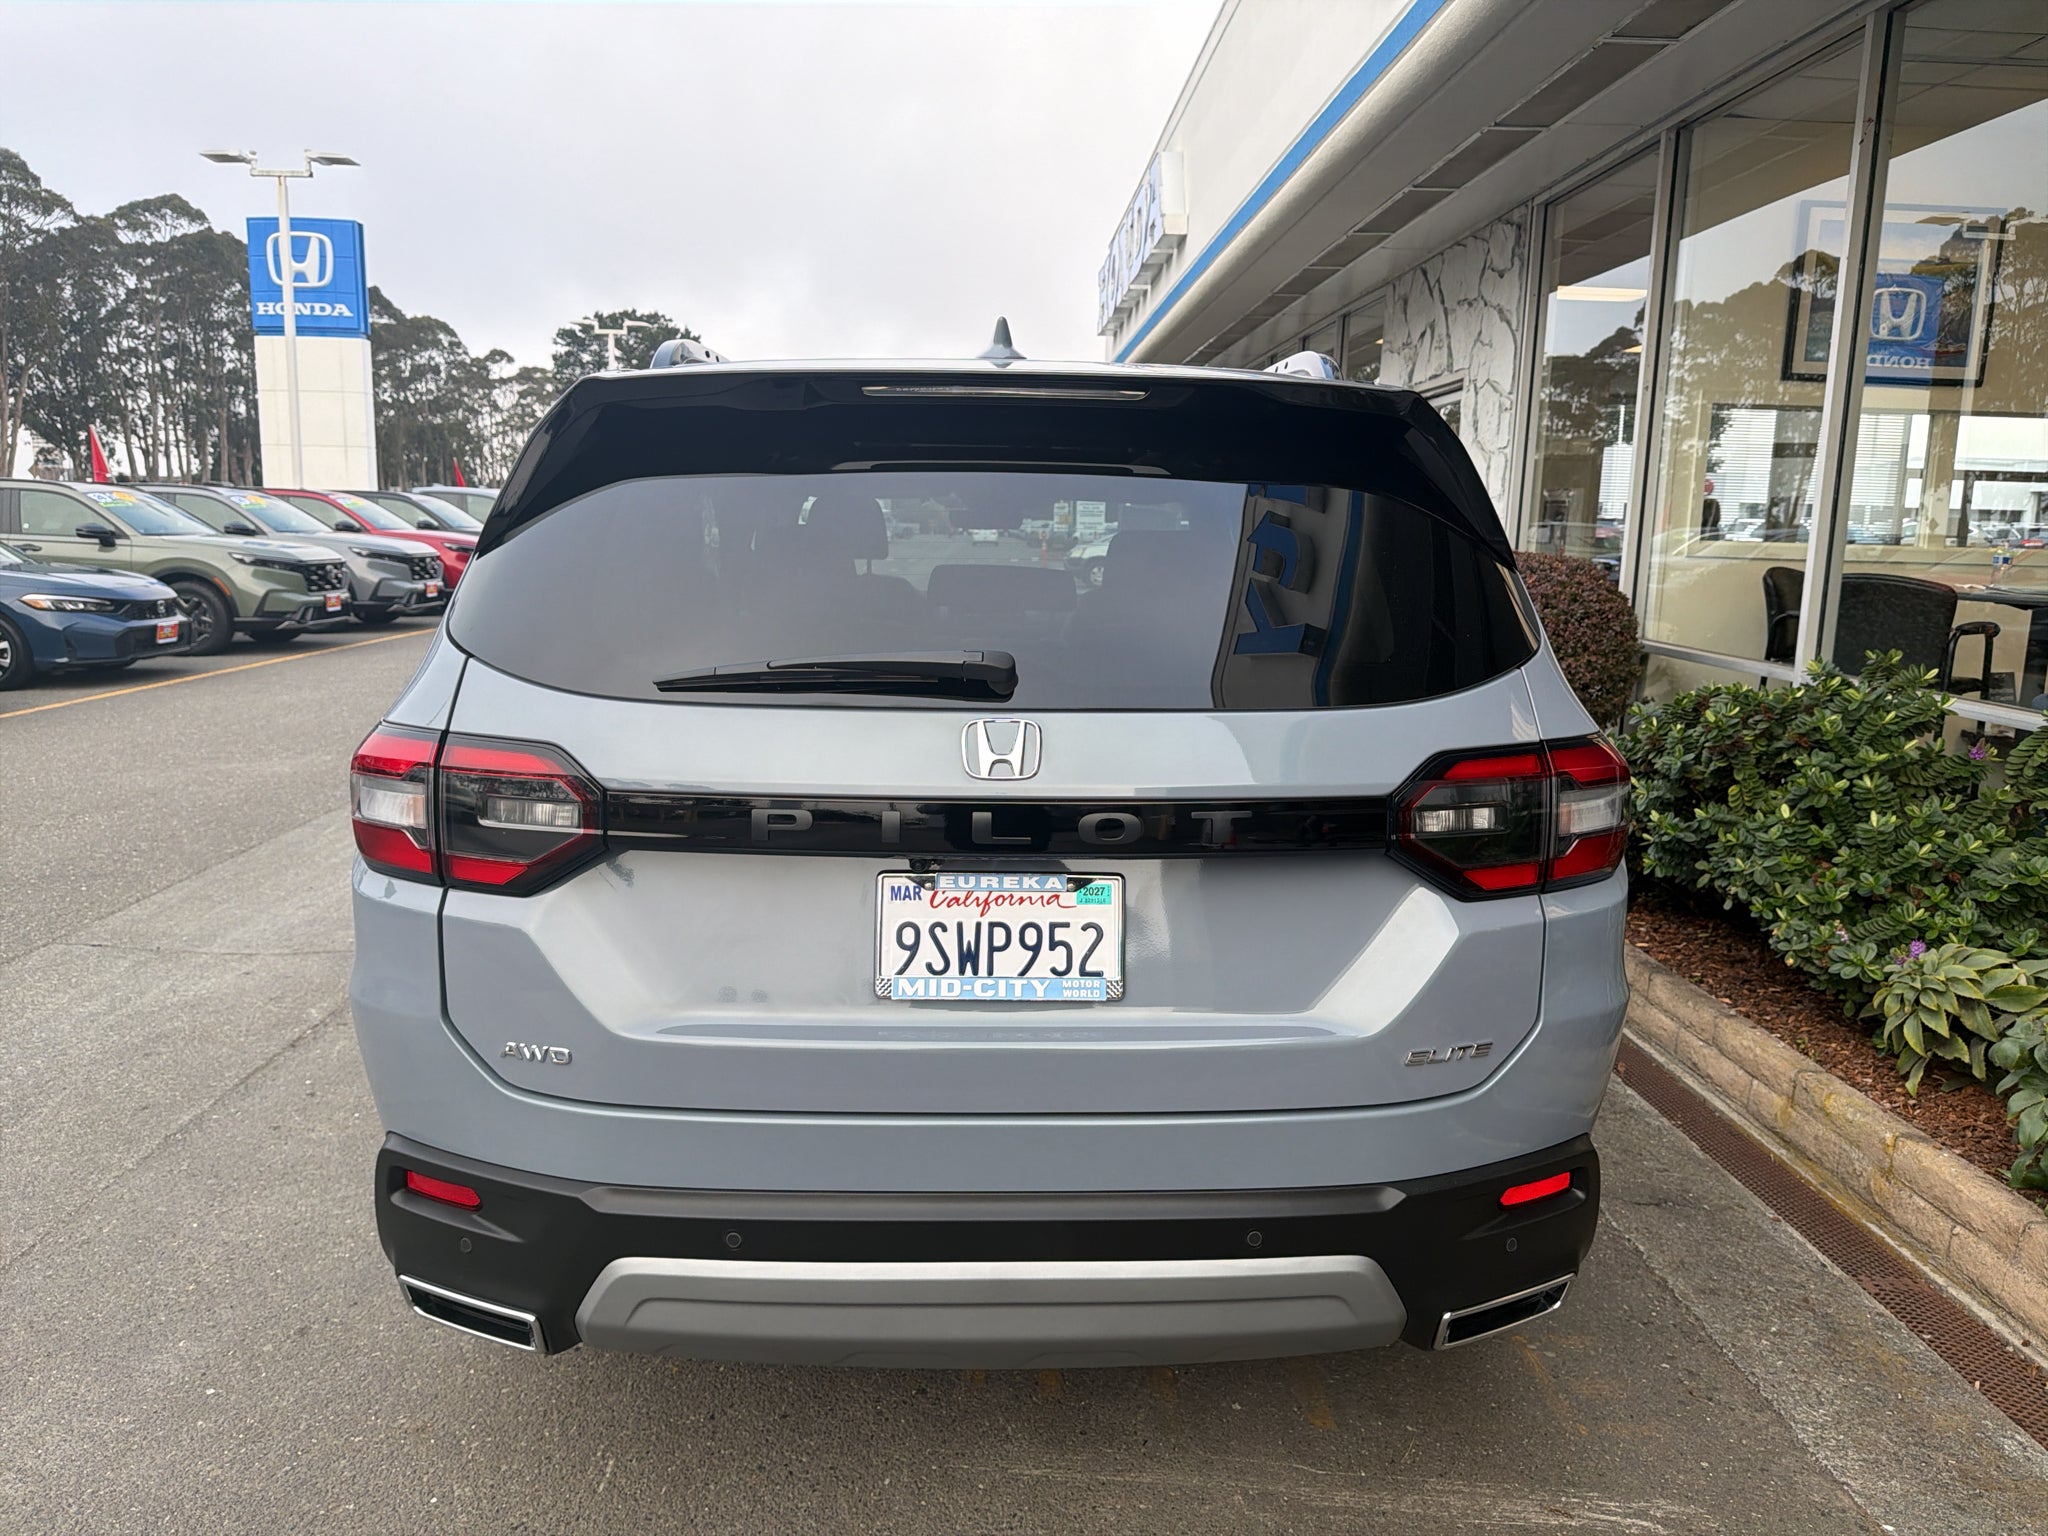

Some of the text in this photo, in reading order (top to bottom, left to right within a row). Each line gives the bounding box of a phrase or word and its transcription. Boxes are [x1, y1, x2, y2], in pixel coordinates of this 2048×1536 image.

[751, 808, 1253, 848] PILOT
[938, 875, 1063, 890] EUREKA
[1083, 886, 1106, 896] 2027
[890, 885, 922, 901] MAR
[929, 889, 1078, 918] California
[894, 920, 1105, 978] 9SWP952
[898, 979, 1051, 998] MID-CITY
[1062, 981, 1101, 989] MOTOR
[1062, 989, 1101, 998] WORLD
[500, 1041, 573, 1065] AWD
[1405, 1042, 1493, 1067] ELITE
